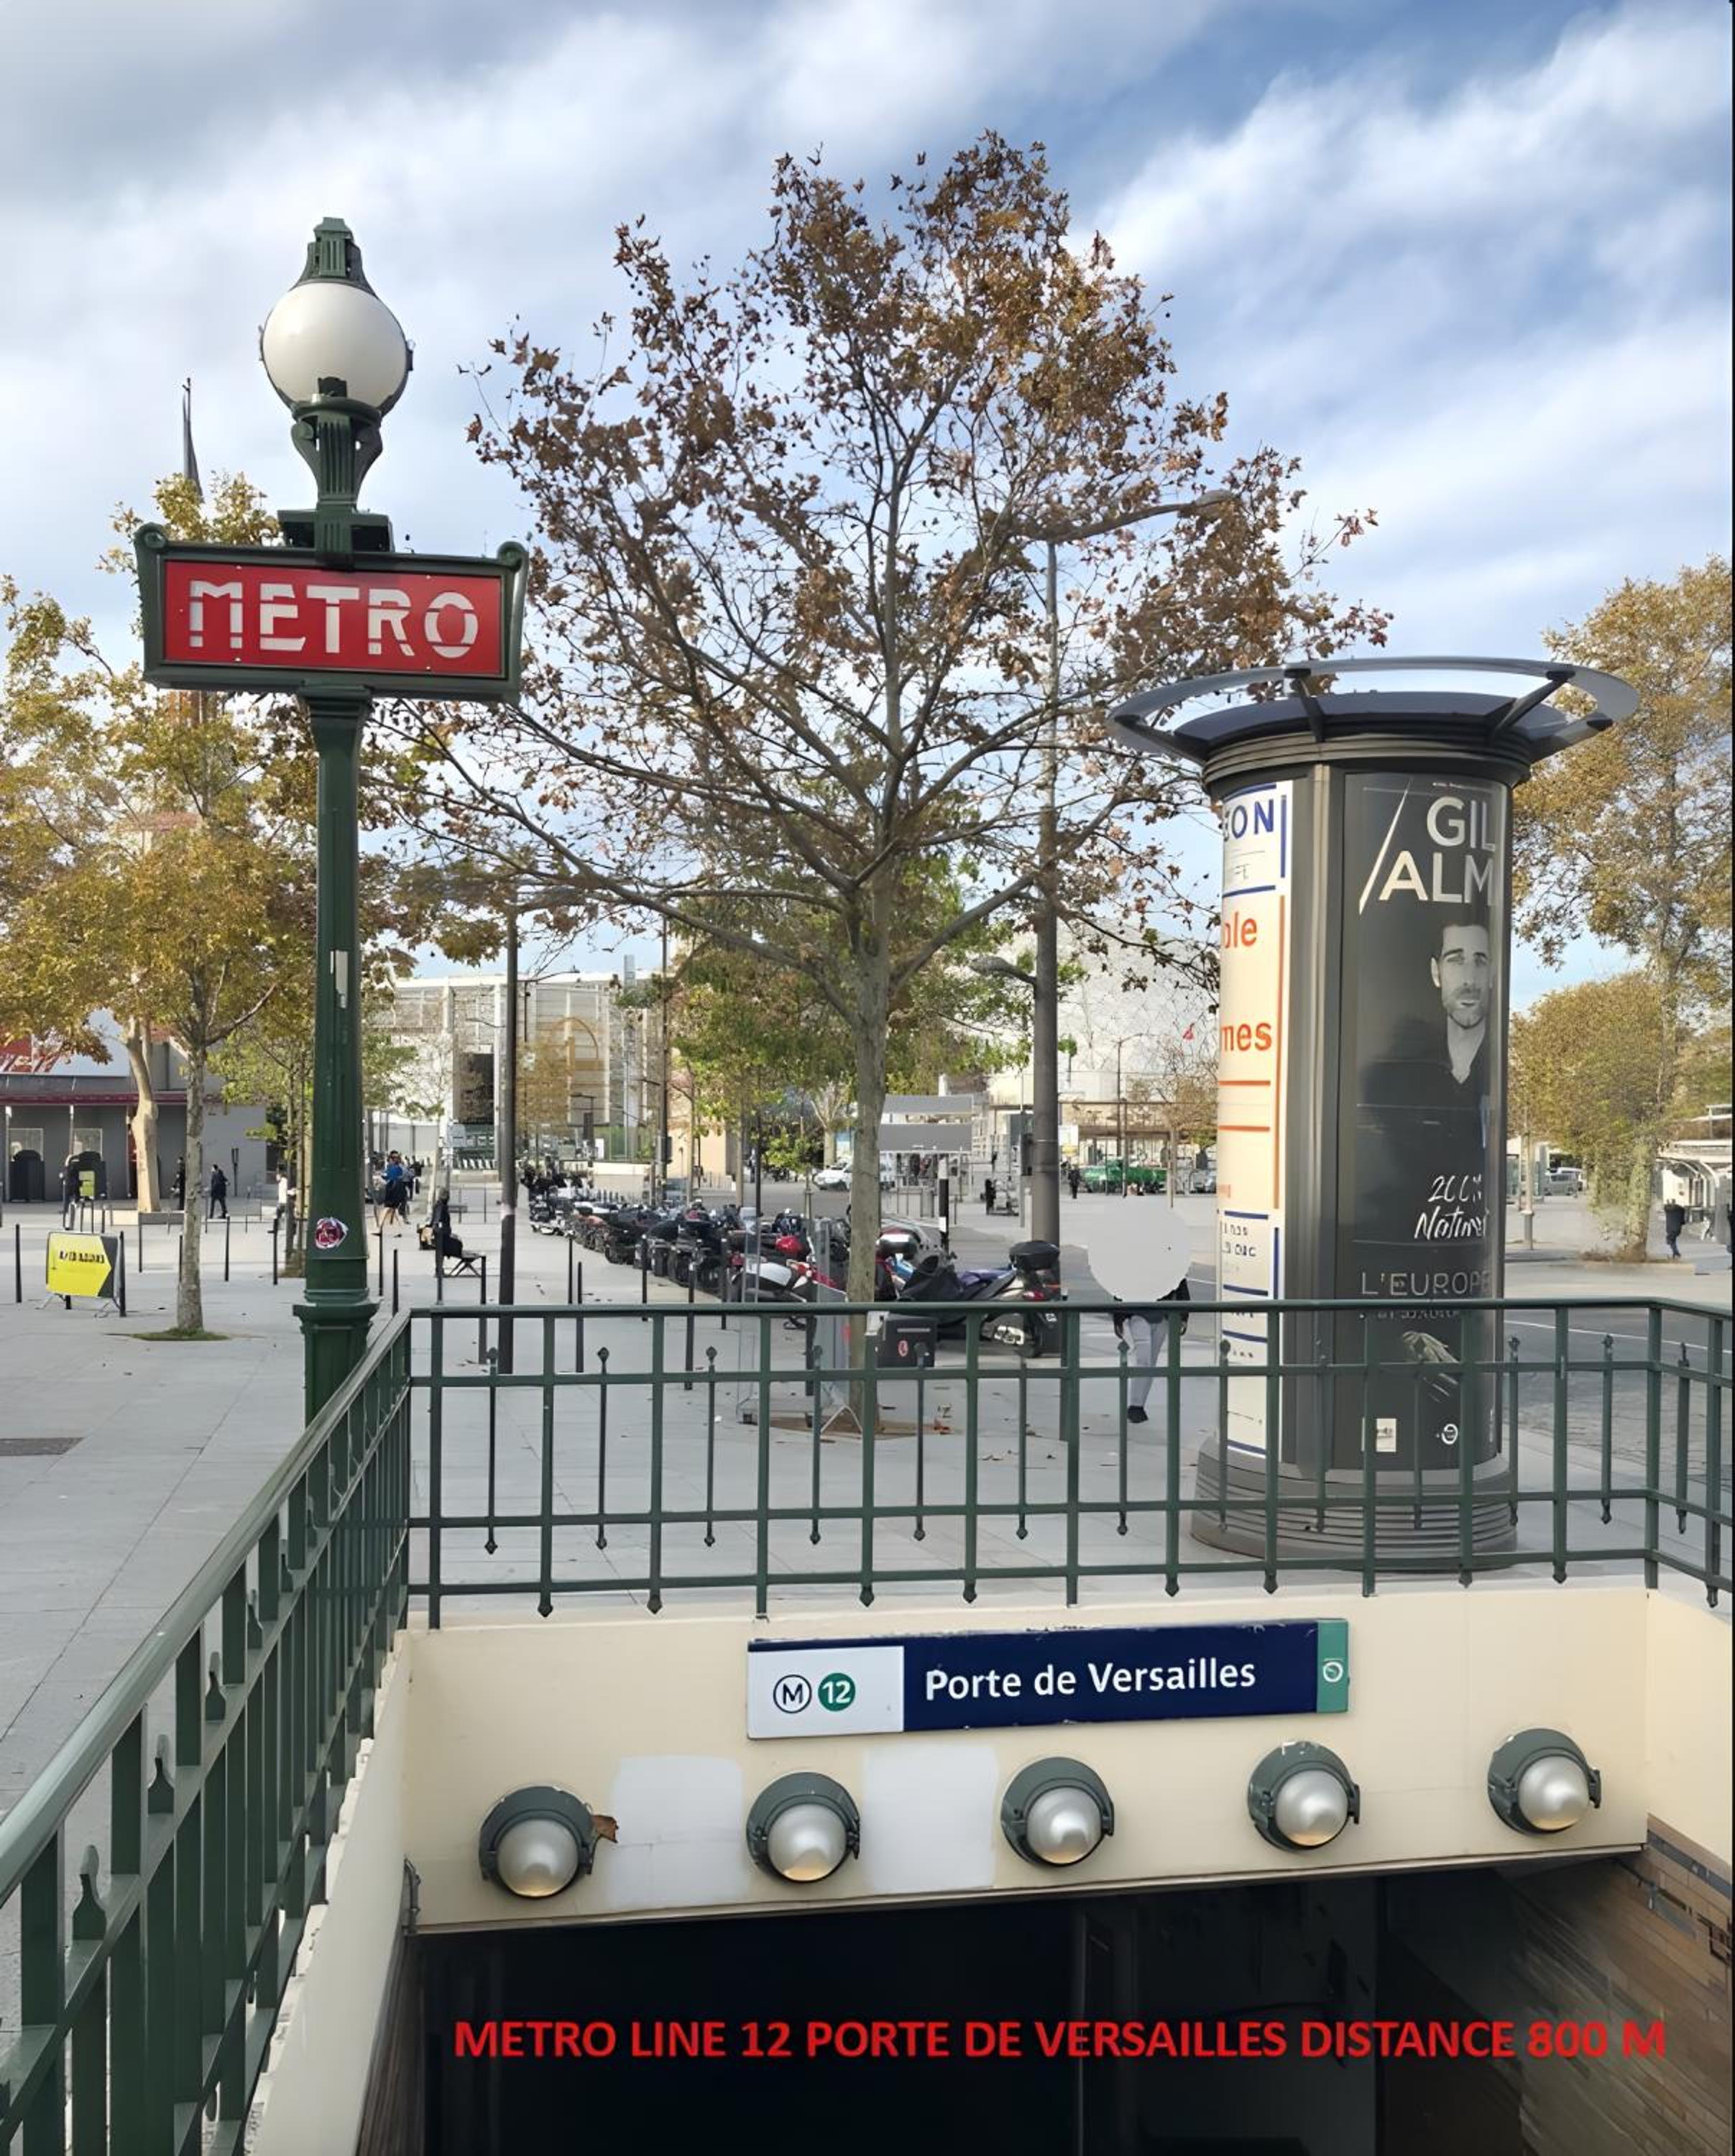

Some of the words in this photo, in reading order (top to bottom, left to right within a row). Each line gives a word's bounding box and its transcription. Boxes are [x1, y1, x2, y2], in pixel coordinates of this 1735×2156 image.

[190, 580, 479, 659] METRO
[925, 1668, 1021, 1700] Porte
[1034, 1664, 1076, 1695] de
[1088, 1657, 1256, 1692] Versailles
